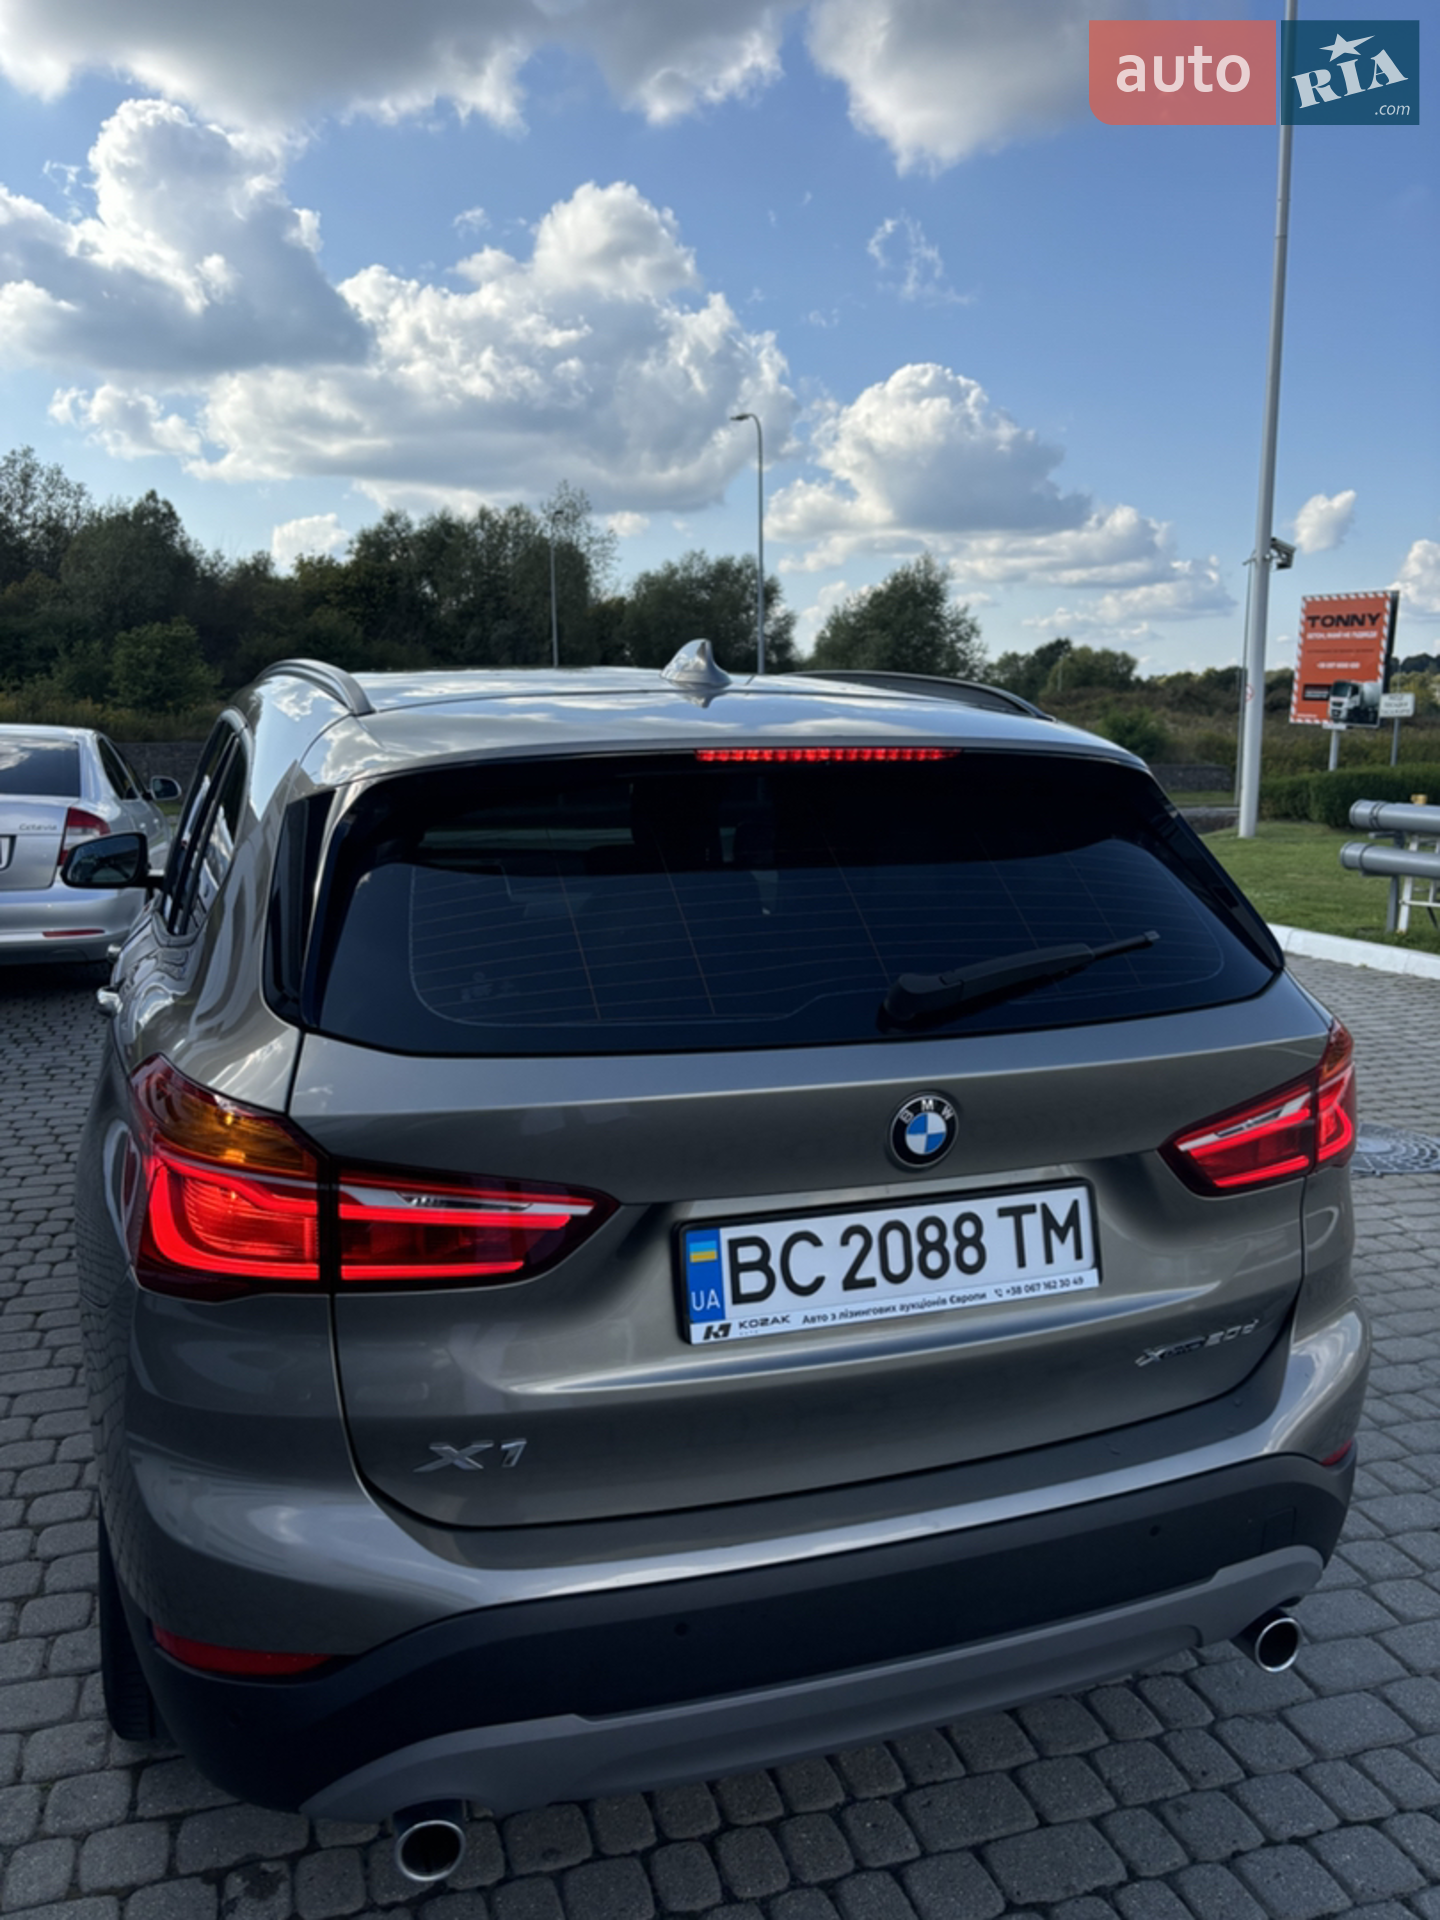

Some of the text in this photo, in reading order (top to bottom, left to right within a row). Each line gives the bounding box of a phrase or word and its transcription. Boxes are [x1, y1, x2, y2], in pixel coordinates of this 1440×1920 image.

[1306, 612, 1381, 628] TONNY
[727, 1198, 1083, 1305] BC 2088 TM
[691, 1288, 721, 1312] UA
[1005, 1285, 1022, 1297] +38
[802, 1313, 828, 1325] Авто
[838, 1305, 897, 1320] лізингових
[899, 1296, 948, 1313] аукціонів
[949, 1291, 987, 1305] Європи
[738, 1315, 791, 1330] KOZAK
[412, 1437, 527, 1473] X1
